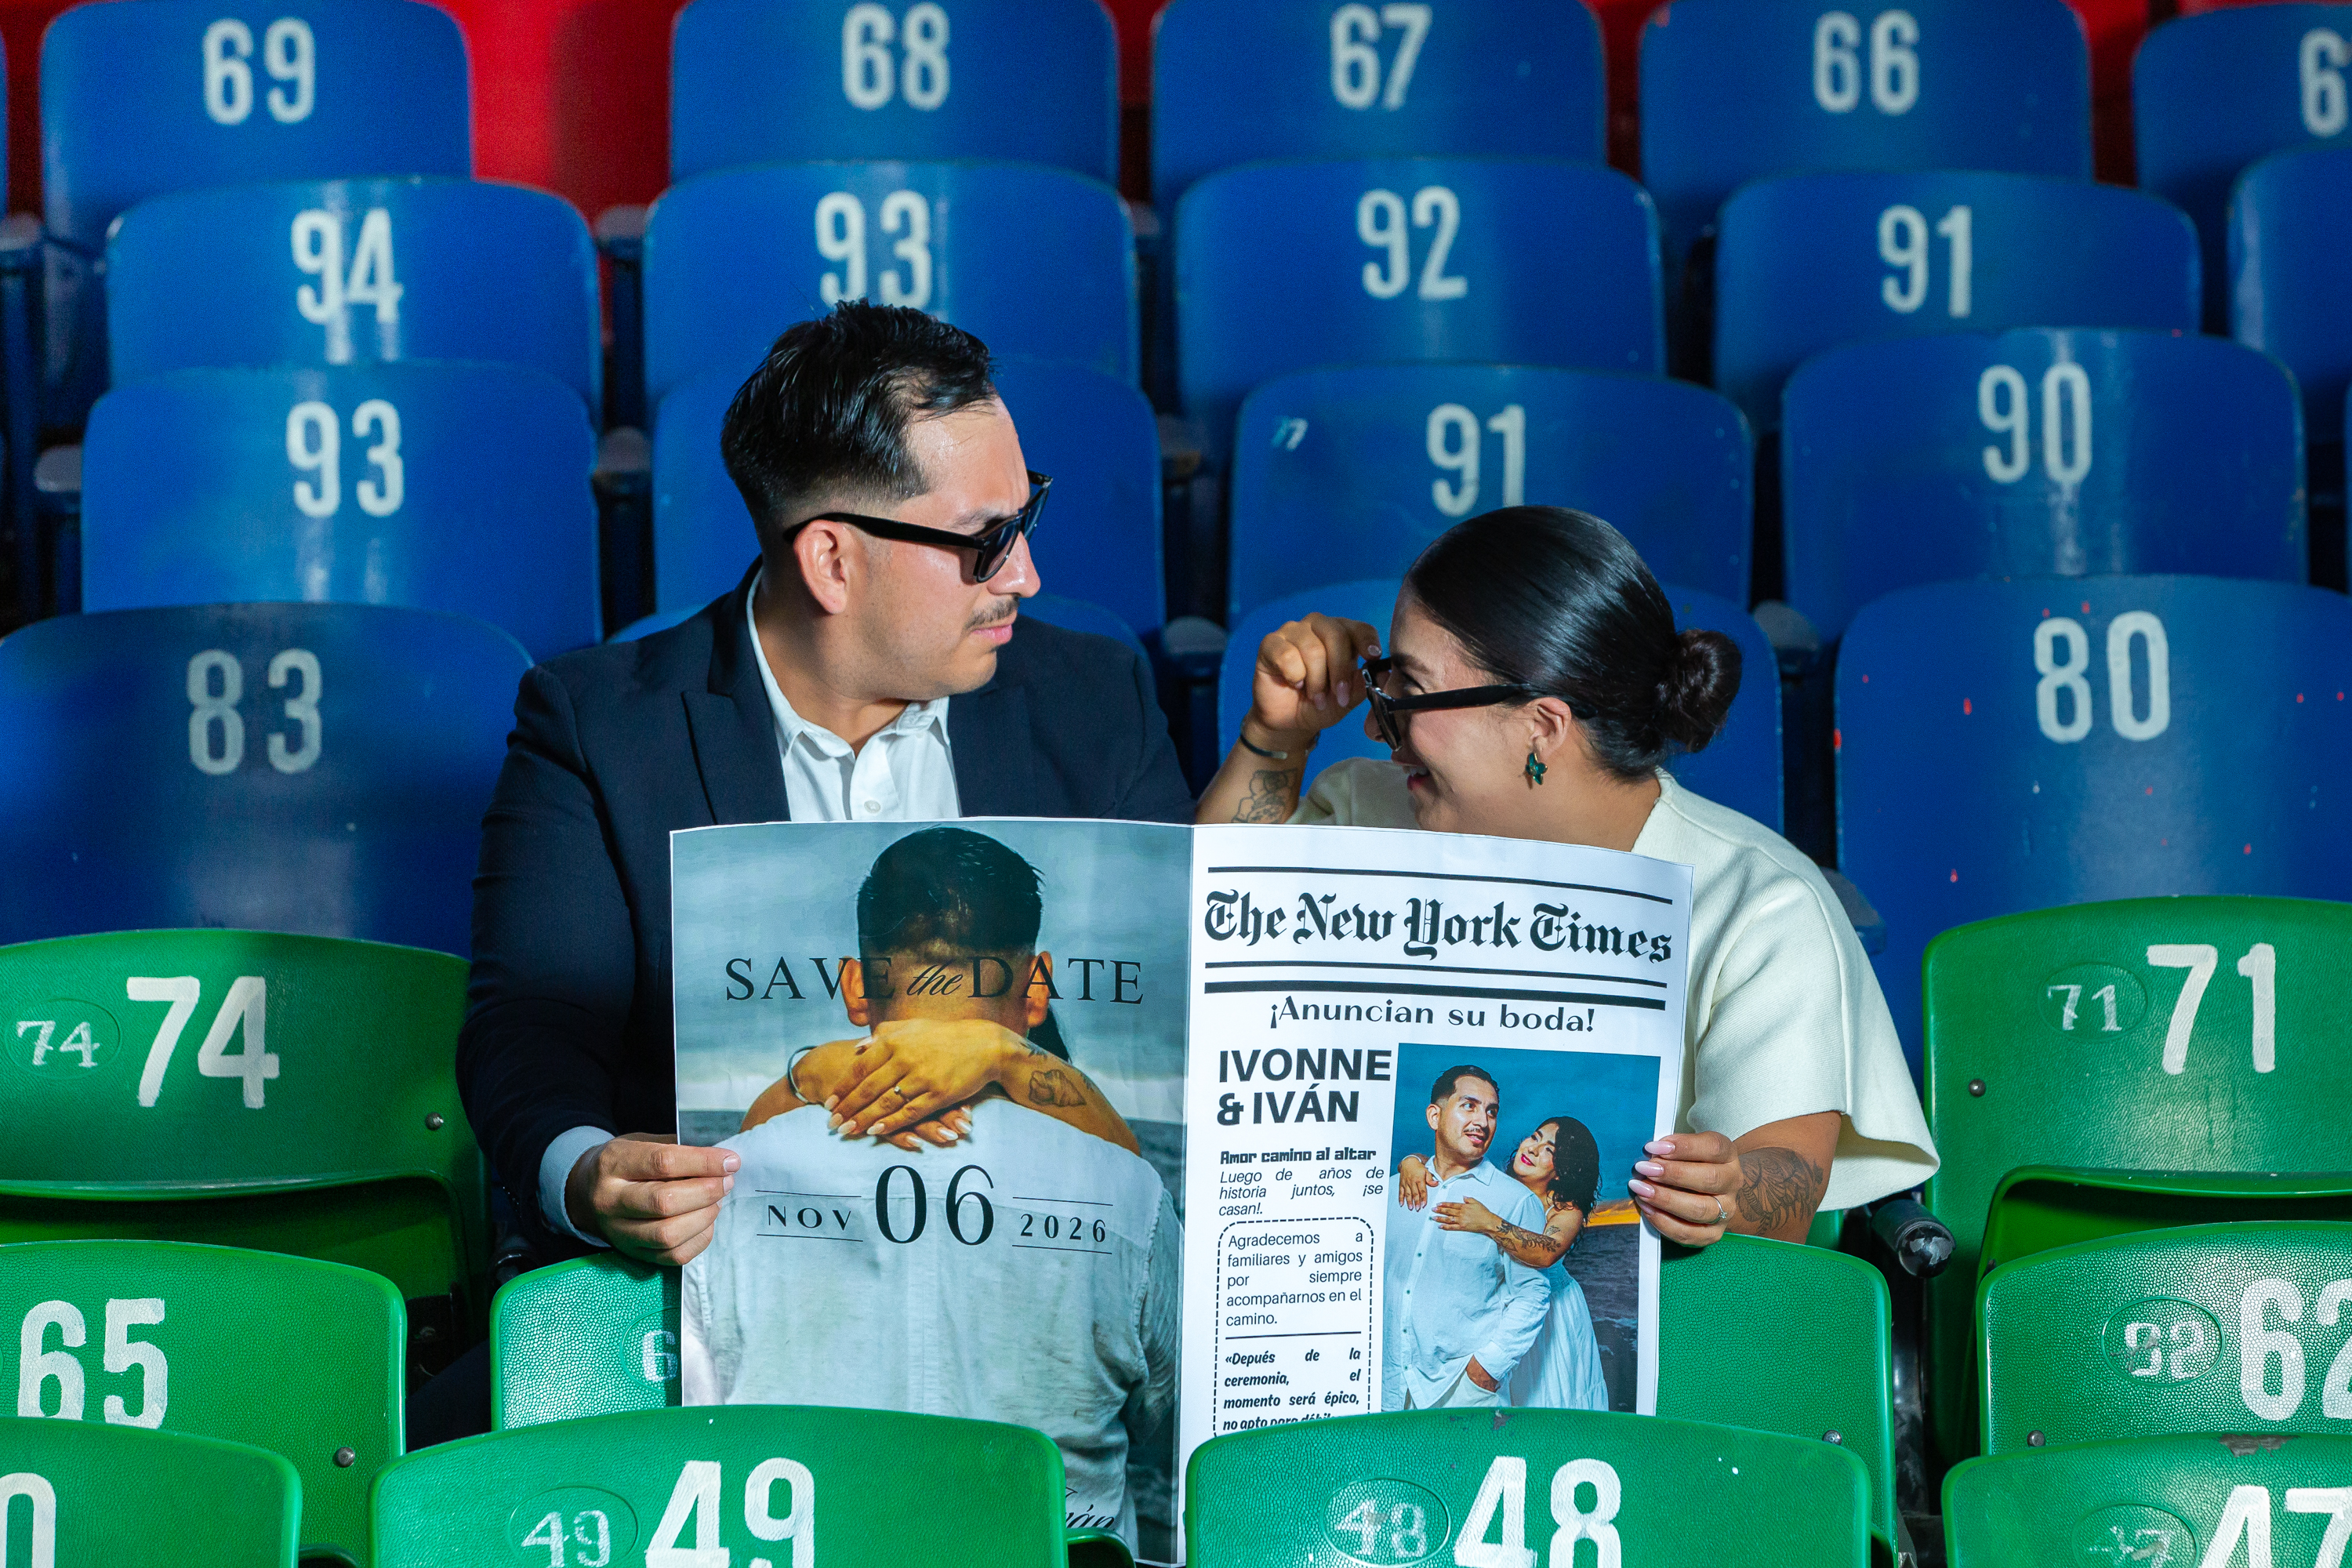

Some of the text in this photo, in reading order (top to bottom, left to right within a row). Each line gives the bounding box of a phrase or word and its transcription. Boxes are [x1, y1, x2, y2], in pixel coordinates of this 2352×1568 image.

[203, 18, 315, 125] 69
[842, 3, 949, 110] 68
[1330, 3, 1432, 110] 67
[1813, 9, 1919, 114] 66
[2299, 29, 2352, 136] 6
[291, 208, 403, 324] 94
[815, 190, 931, 310] 93
[1358, 186, 1467, 300] 92
[1879, 205, 1972, 317] 91
[285, 400, 404, 517] 93
[1427, 403, 1526, 517] 91
[1978, 362, 2092, 483] 90
[187, 648, 322, 775] 83
[2034, 610, 2170, 743] 80
[1204, 889, 1672, 964] The New York Times
[725, 955, 1145, 1006] SAVE the DATE
[1270, 996, 1595, 1033] ¡Anuncian su boda!
[2047, 984, 2122, 1032] 71
[2146, 942, 2276, 1076] 71
[16, 1020, 100, 1068] 74
[126, 975, 280, 1109] 74
[1219, 1048, 1392, 1083] IVONNE
[1217, 1083, 1359, 1127] & IVÁN
[1219, 1185, 1384, 1200] historia juntos, ¡se
[1220, 1147, 1377, 1165] Amor camino al altar
[1220, 1167, 1385, 1185] Luego de años de
[766, 1164, 1107, 1246] NOV 06 2026
[1219, 1203, 1263, 1216] casan!.
[1228, 1232, 1363, 1250] Agradecemos a
[1227, 1271, 1363, 1290] por siempre
[1228, 1250, 1363, 1267] familiares y amigos
[1225, 1312, 1278, 1327] camino.
[1226, 1288, 1362, 1308] acompañarnos en el
[17, 1298, 168, 1428] 65
[642, 1330, 678, 1382] 6
[1224, 1368, 1362, 1387] ceremonia, el
[1225, 1347, 1361, 1367] «Depués de la
[2240, 1278, 2352, 1421] 62
[1222, 1420, 1238, 1431] no
[1240, 1416, 1268, 1430] apto
[1223, 1390, 1359, 1409] momento será épico,
[0, 1472, 56, 1568] 0
[521, 1509, 612, 1568] 49
[645, 1457, 815, 1568] 49
[1334, 1499, 1427, 1558] 48
[1454, 1455, 1622, 1568] 48
